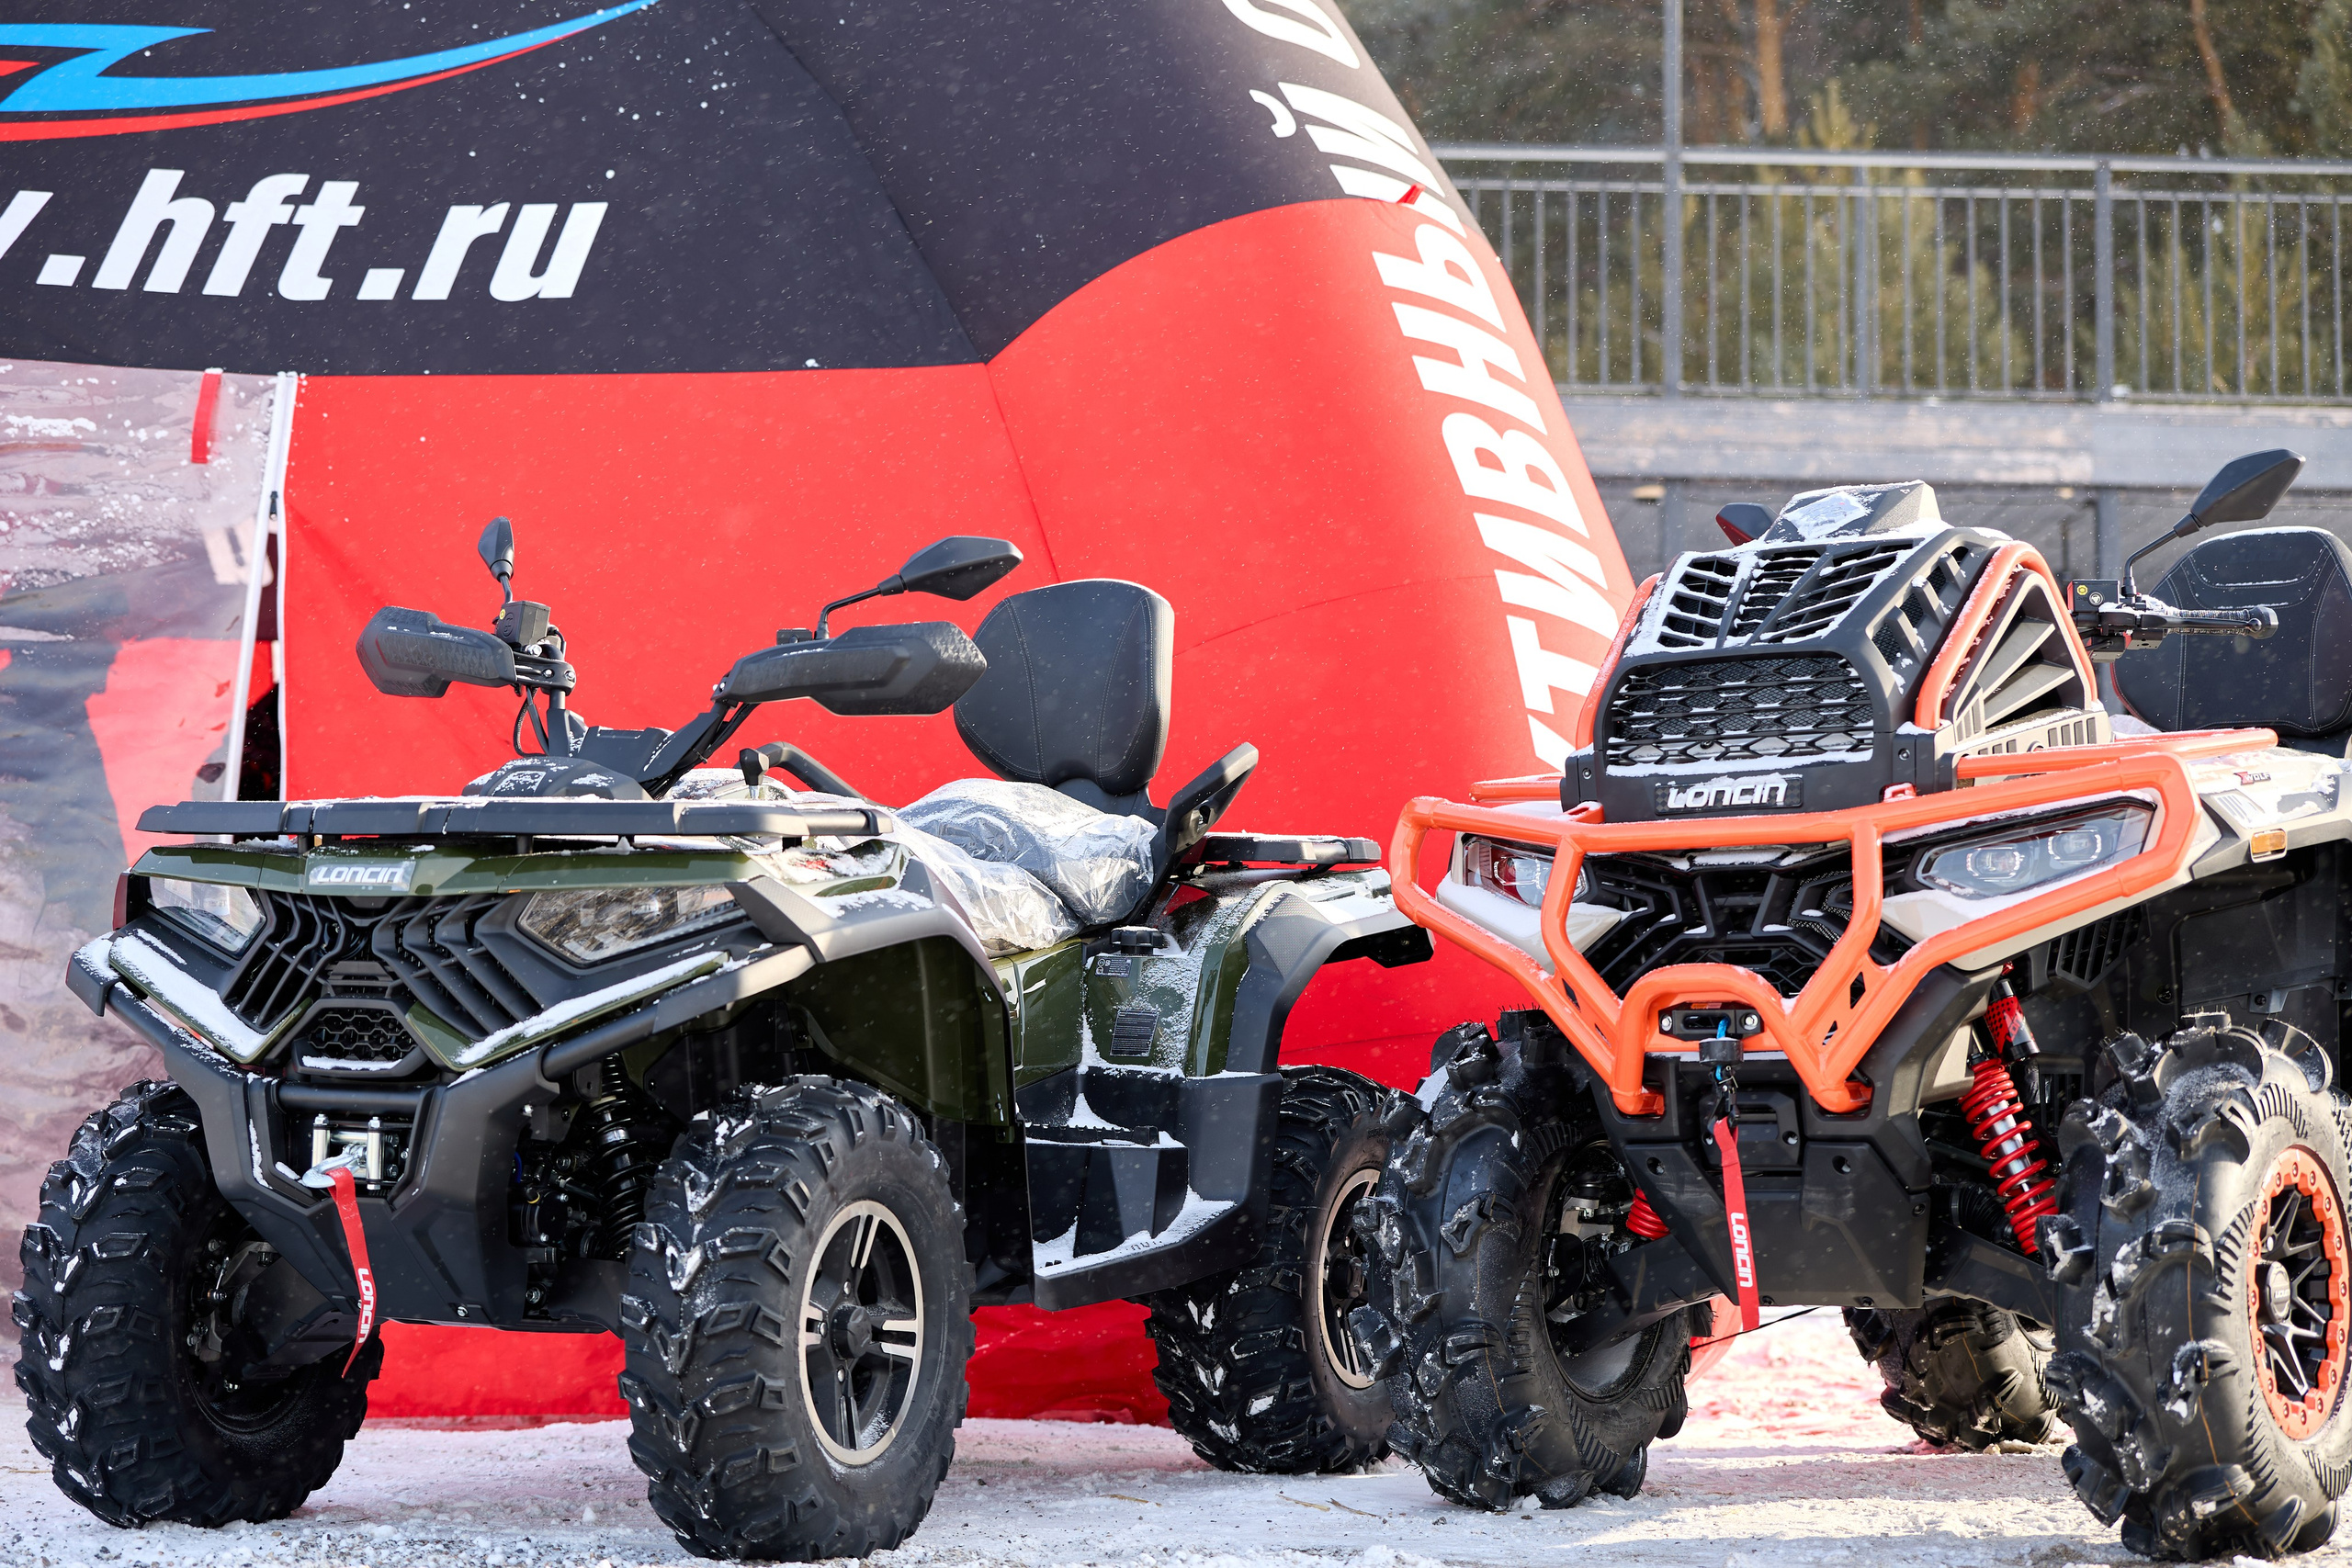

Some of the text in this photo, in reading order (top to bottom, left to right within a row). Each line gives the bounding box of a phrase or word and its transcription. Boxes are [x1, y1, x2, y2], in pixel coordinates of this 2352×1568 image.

[1249, 81, 1619, 773] ТИВНЫЙ
[1667, 782, 1788, 809] LONCIN
[316, 866, 404, 884] LONCIN
[1730, 1212, 1753, 1288] LONCIN
[357, 1268, 375, 1344] LONCIN
